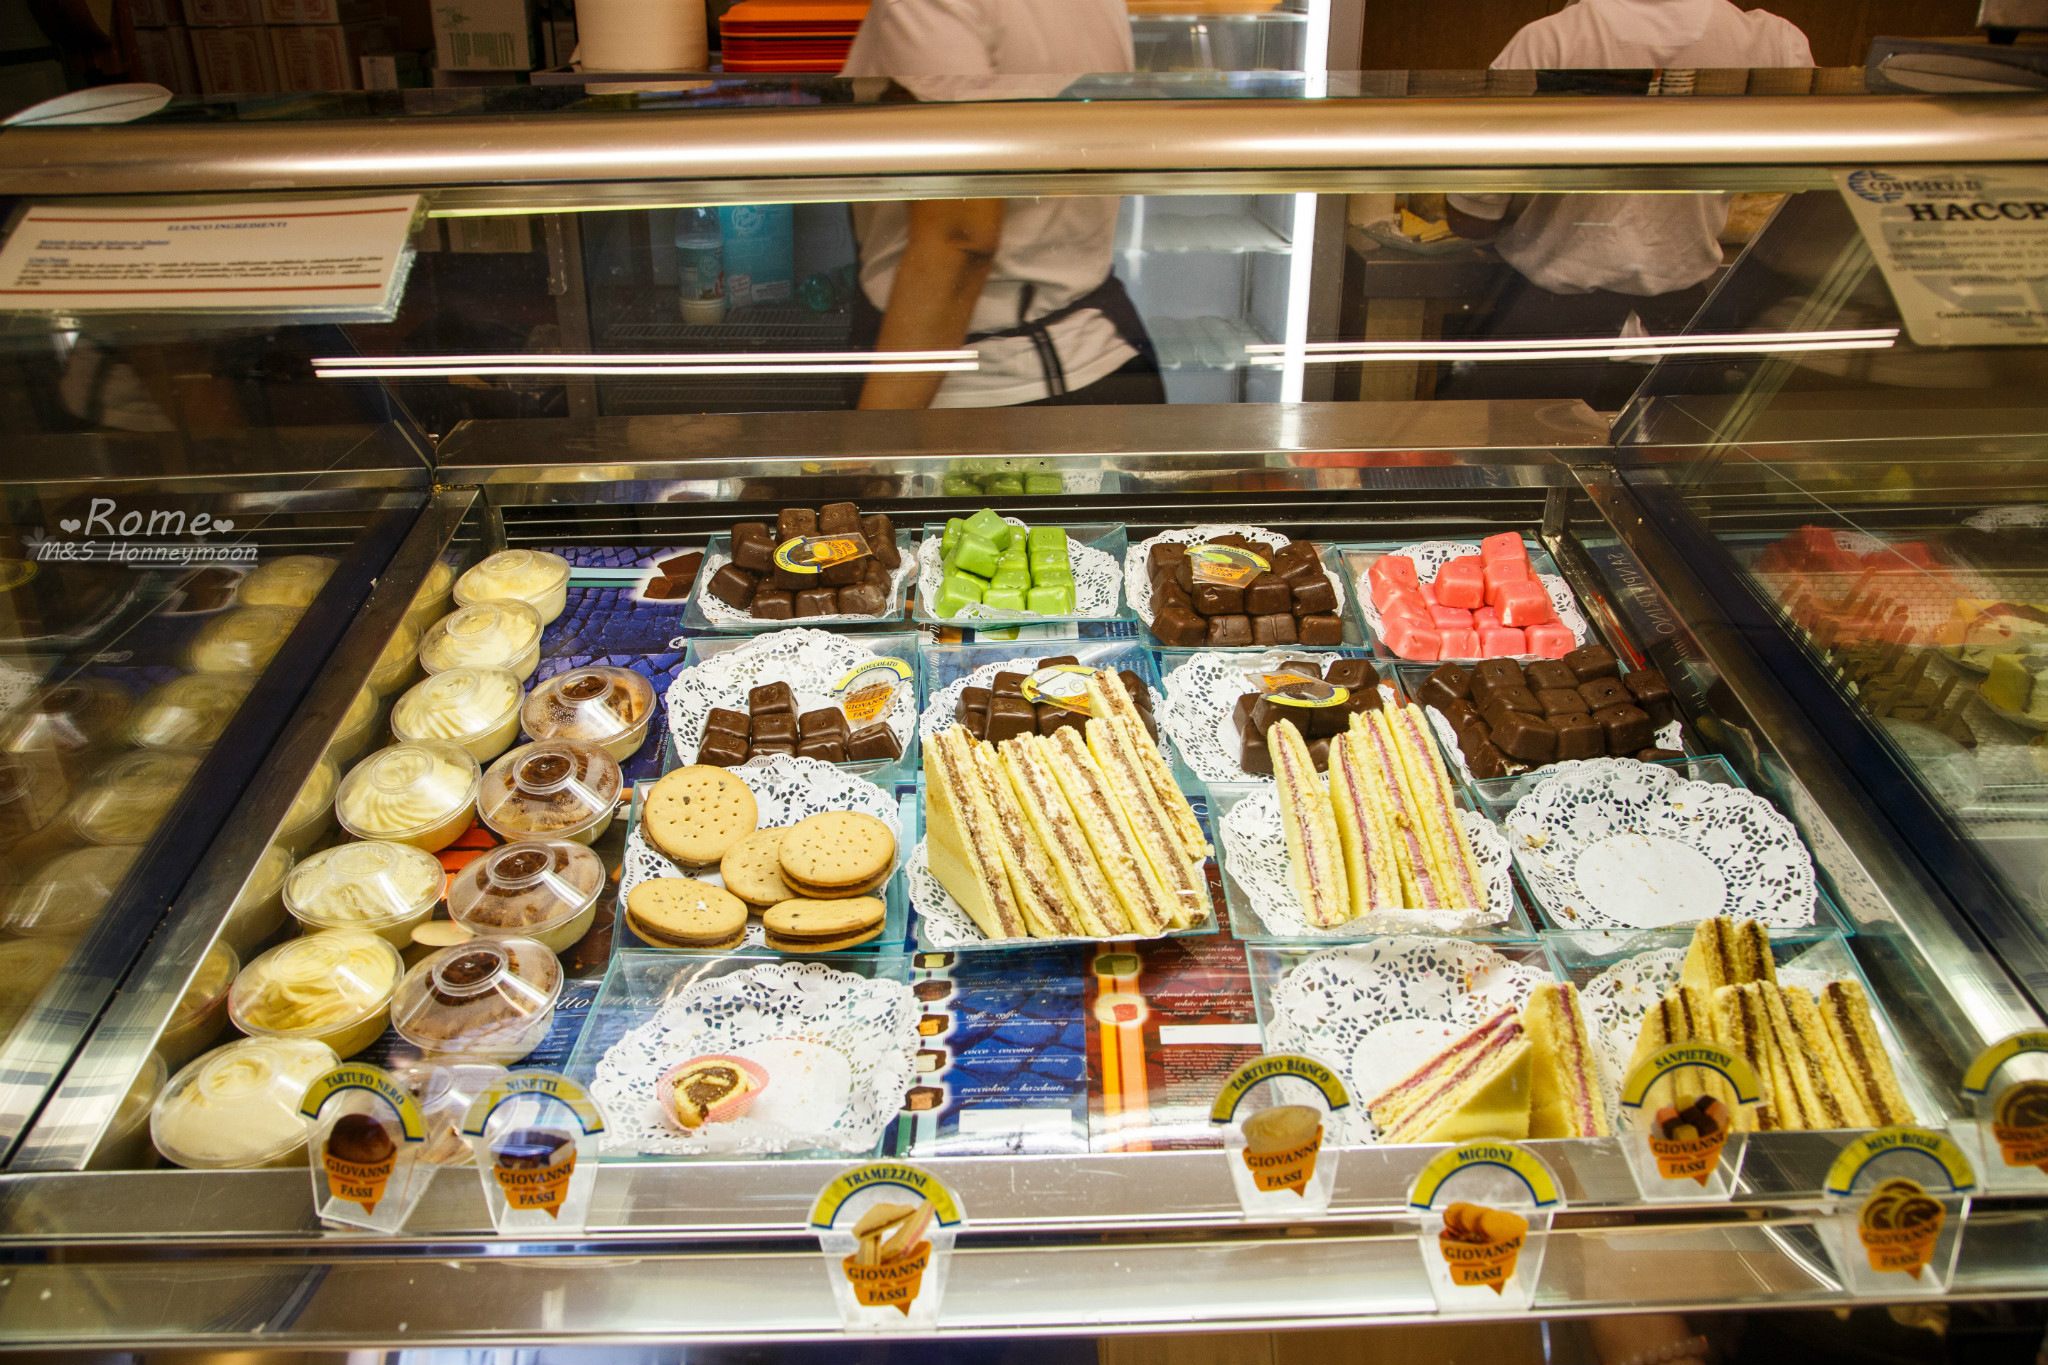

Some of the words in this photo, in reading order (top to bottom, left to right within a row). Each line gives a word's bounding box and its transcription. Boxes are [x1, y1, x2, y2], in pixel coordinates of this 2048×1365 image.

[449, 32, 471, 66] TOP
[1906, 202, 2048, 221] HACCP
[856, 661, 899, 673] CIOCCOLATO
[846, 694, 888, 709] GIOVANNI
[853, 708, 875, 717] FASSI
[1654, 1049, 1733, 1070] SANPIETRINI
[1230, 1061, 1283, 1091] TARTUFO
[1287, 1059, 1330, 1083] BIANCO
[323, 1072, 374, 1089] TARTUFO
[377, 1079, 405, 1105] NERO
[506, 1080, 558, 1093] NINETTI
[1654, 1133, 1724, 1155] GIOVANNI
[1247, 1140, 1320, 1168] GIOVANNI
[1458, 1147, 1513, 1162] MICIONI
[326, 1159, 391, 1178] GIOVANNI
[500, 1163, 572, 1185] GIOVANNI
[1670, 1160, 1706, 1174] FASSI
[843, 1167, 928, 1188] TRAMEZZINI
[1267, 1170, 1303, 1187] FASSI
[341, 1184, 374, 1198] FASSI
[520, 1191, 556, 1205] FASSI
[1445, 1236, 1521, 1260] GIOVANNI
[848, 1256, 926, 1281] GIOVANNI
[1464, 1266, 1503, 1282] FASSI
[869, 1287, 908, 1302] FASSI
